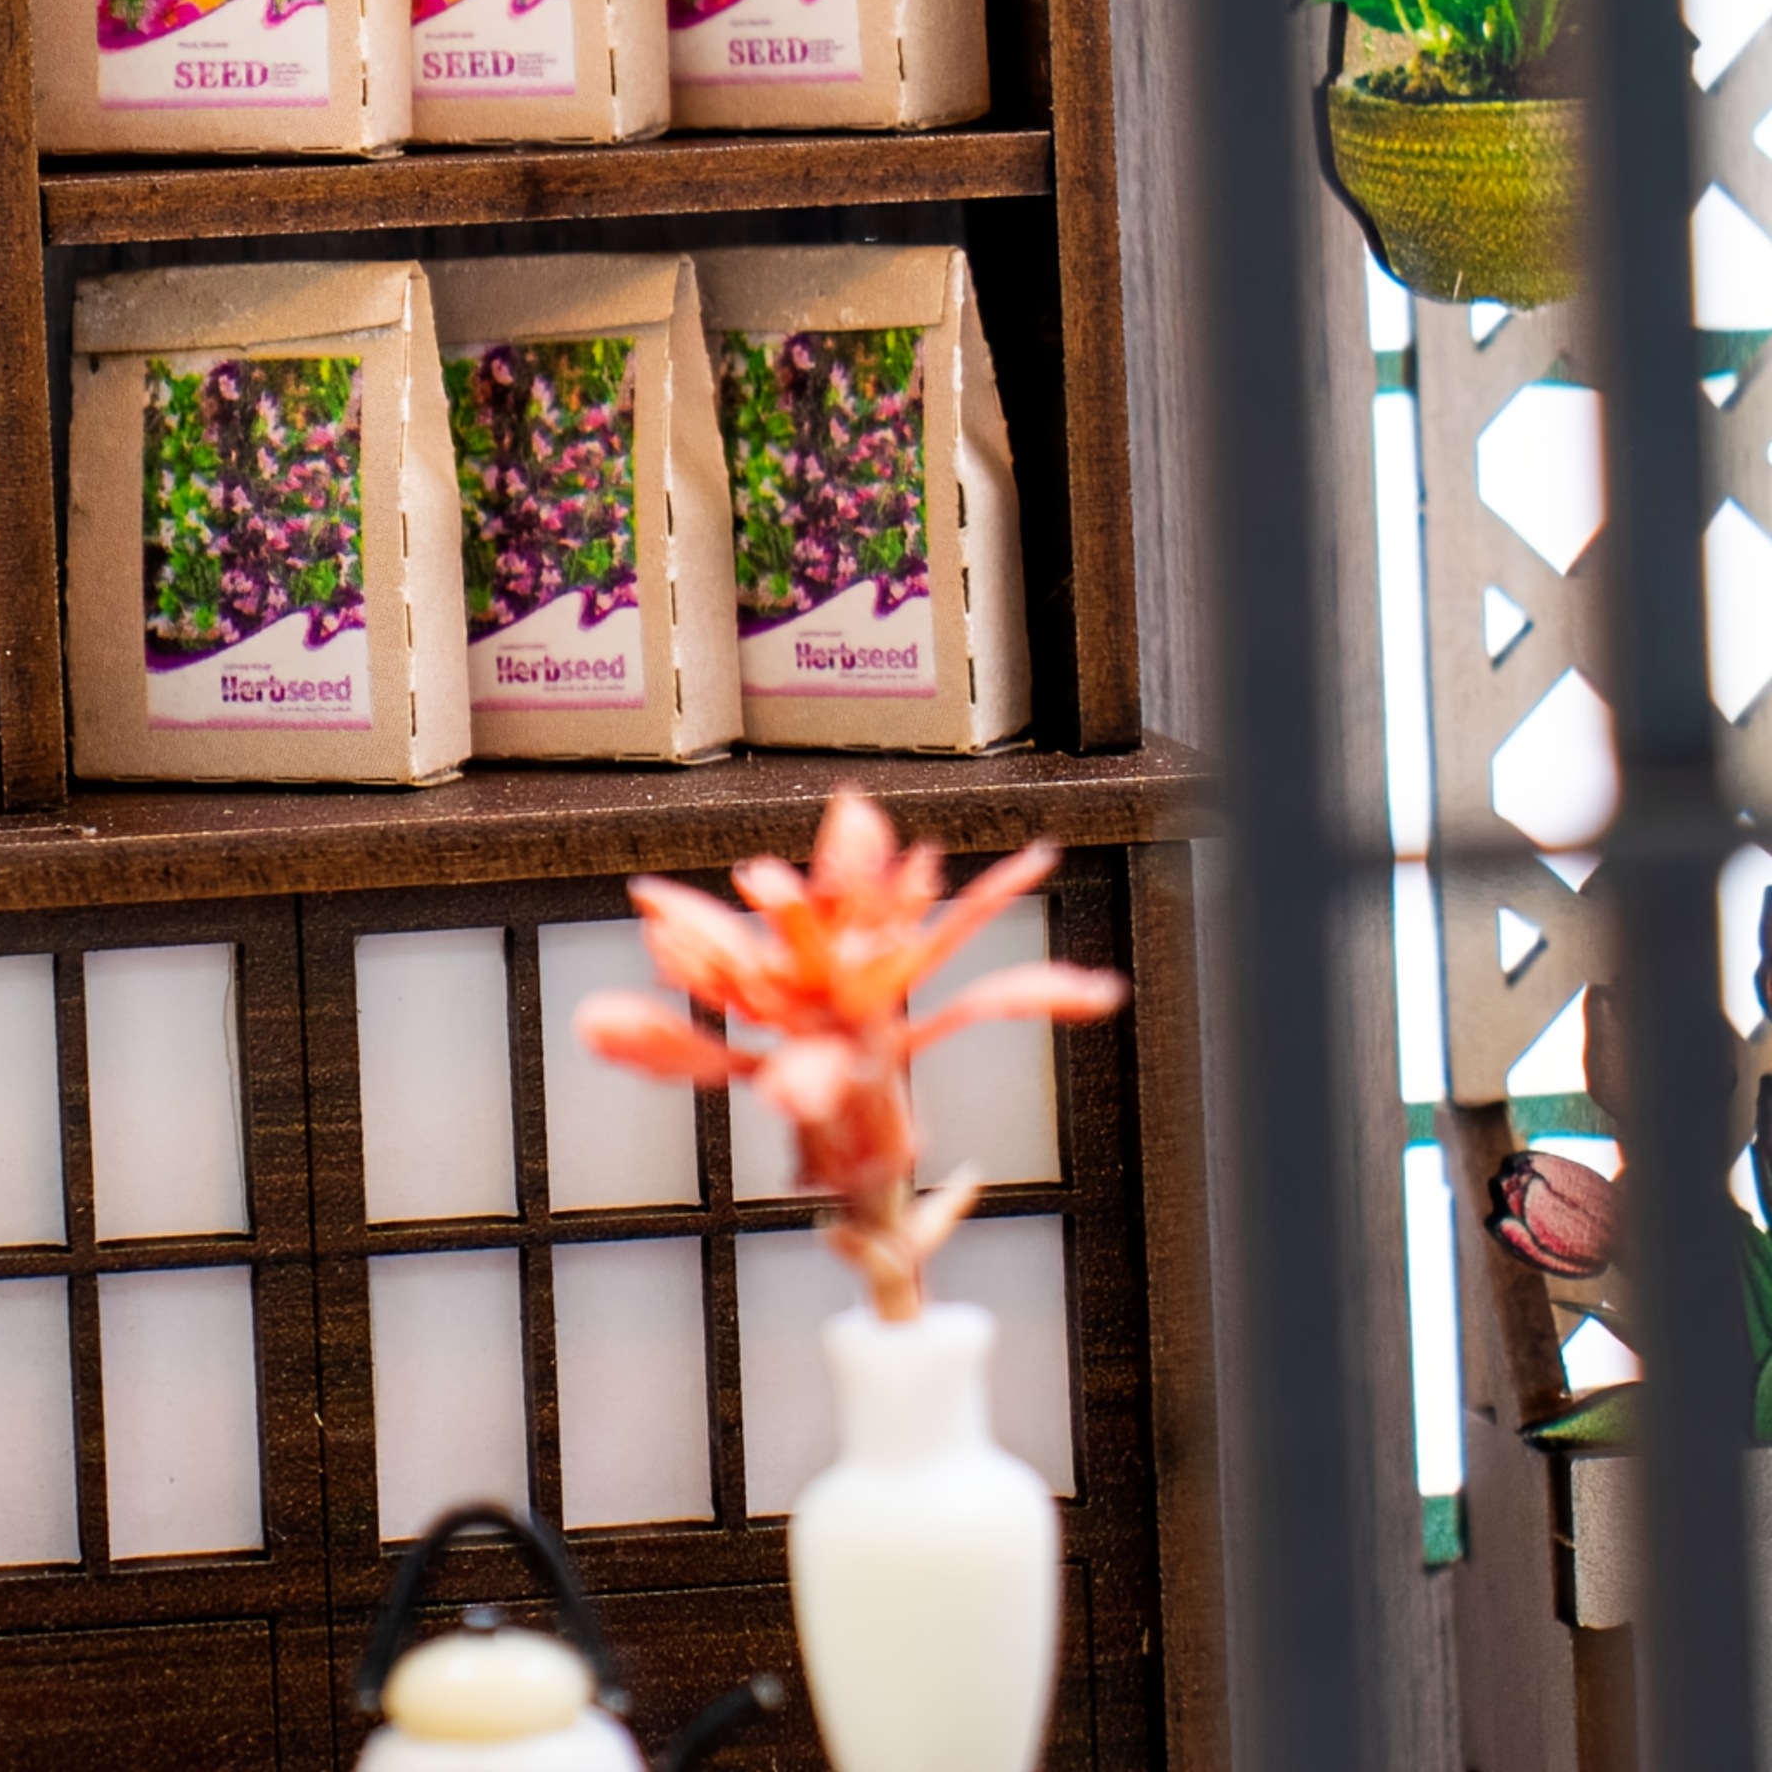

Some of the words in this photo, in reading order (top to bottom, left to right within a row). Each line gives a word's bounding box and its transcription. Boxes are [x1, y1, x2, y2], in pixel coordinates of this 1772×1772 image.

[422, 50, 515, 79] SEED
[729, 37, 809, 66] SEED
[174, 60, 268, 89] SEED
[496, 654, 626, 684] Herbseed
[795, 641, 918, 670] Herbseed
[220, 674, 352, 703] Herbseed
